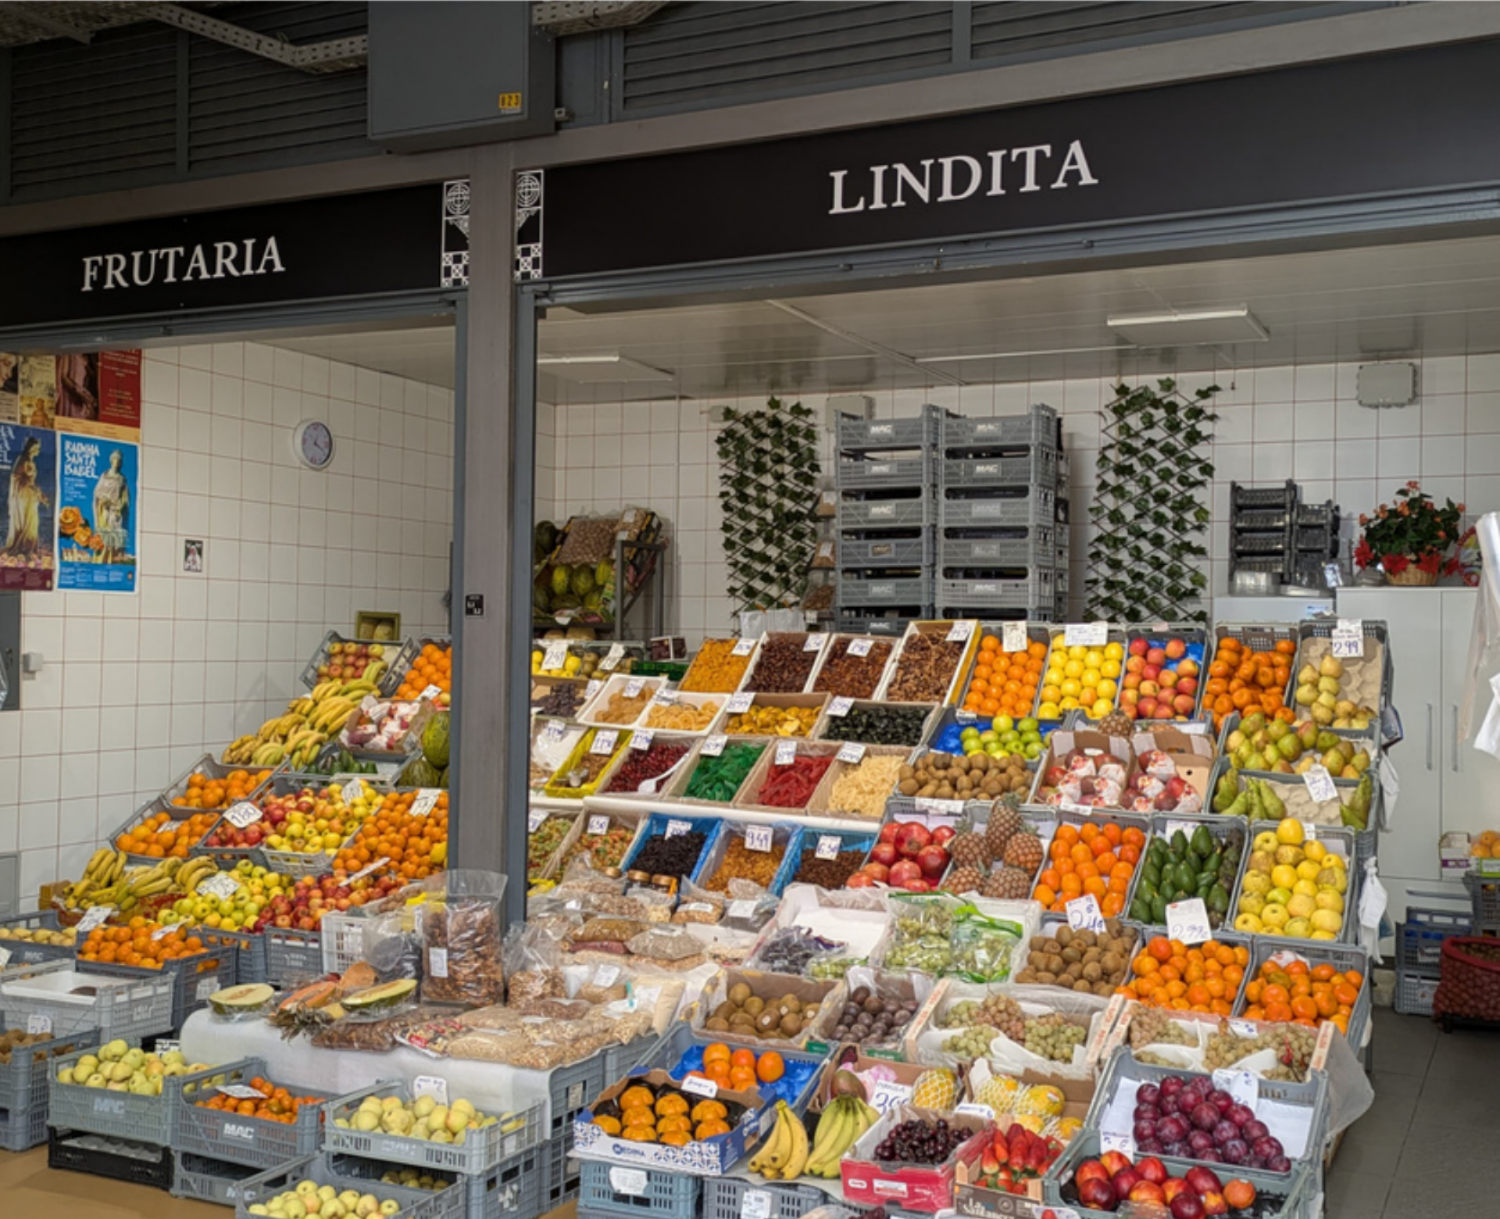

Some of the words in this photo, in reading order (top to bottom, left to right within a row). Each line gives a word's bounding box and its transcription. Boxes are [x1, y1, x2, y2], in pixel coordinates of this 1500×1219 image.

[826, 139, 1099, 215] LINDITA
[80, 235, 287, 293] FRUTARIA
[870, 424, 893, 434] MAC
[64, 440, 100, 457] RAINHA
[64, 451, 97, 467] SANTA
[64, 463, 100, 480] ISABEL
[976, 464, 999, 473] MAC
[871, 505, 893, 514] MAC
[223, 1123, 255, 1139] MAC
[226, 1185, 257, 1201] MC
